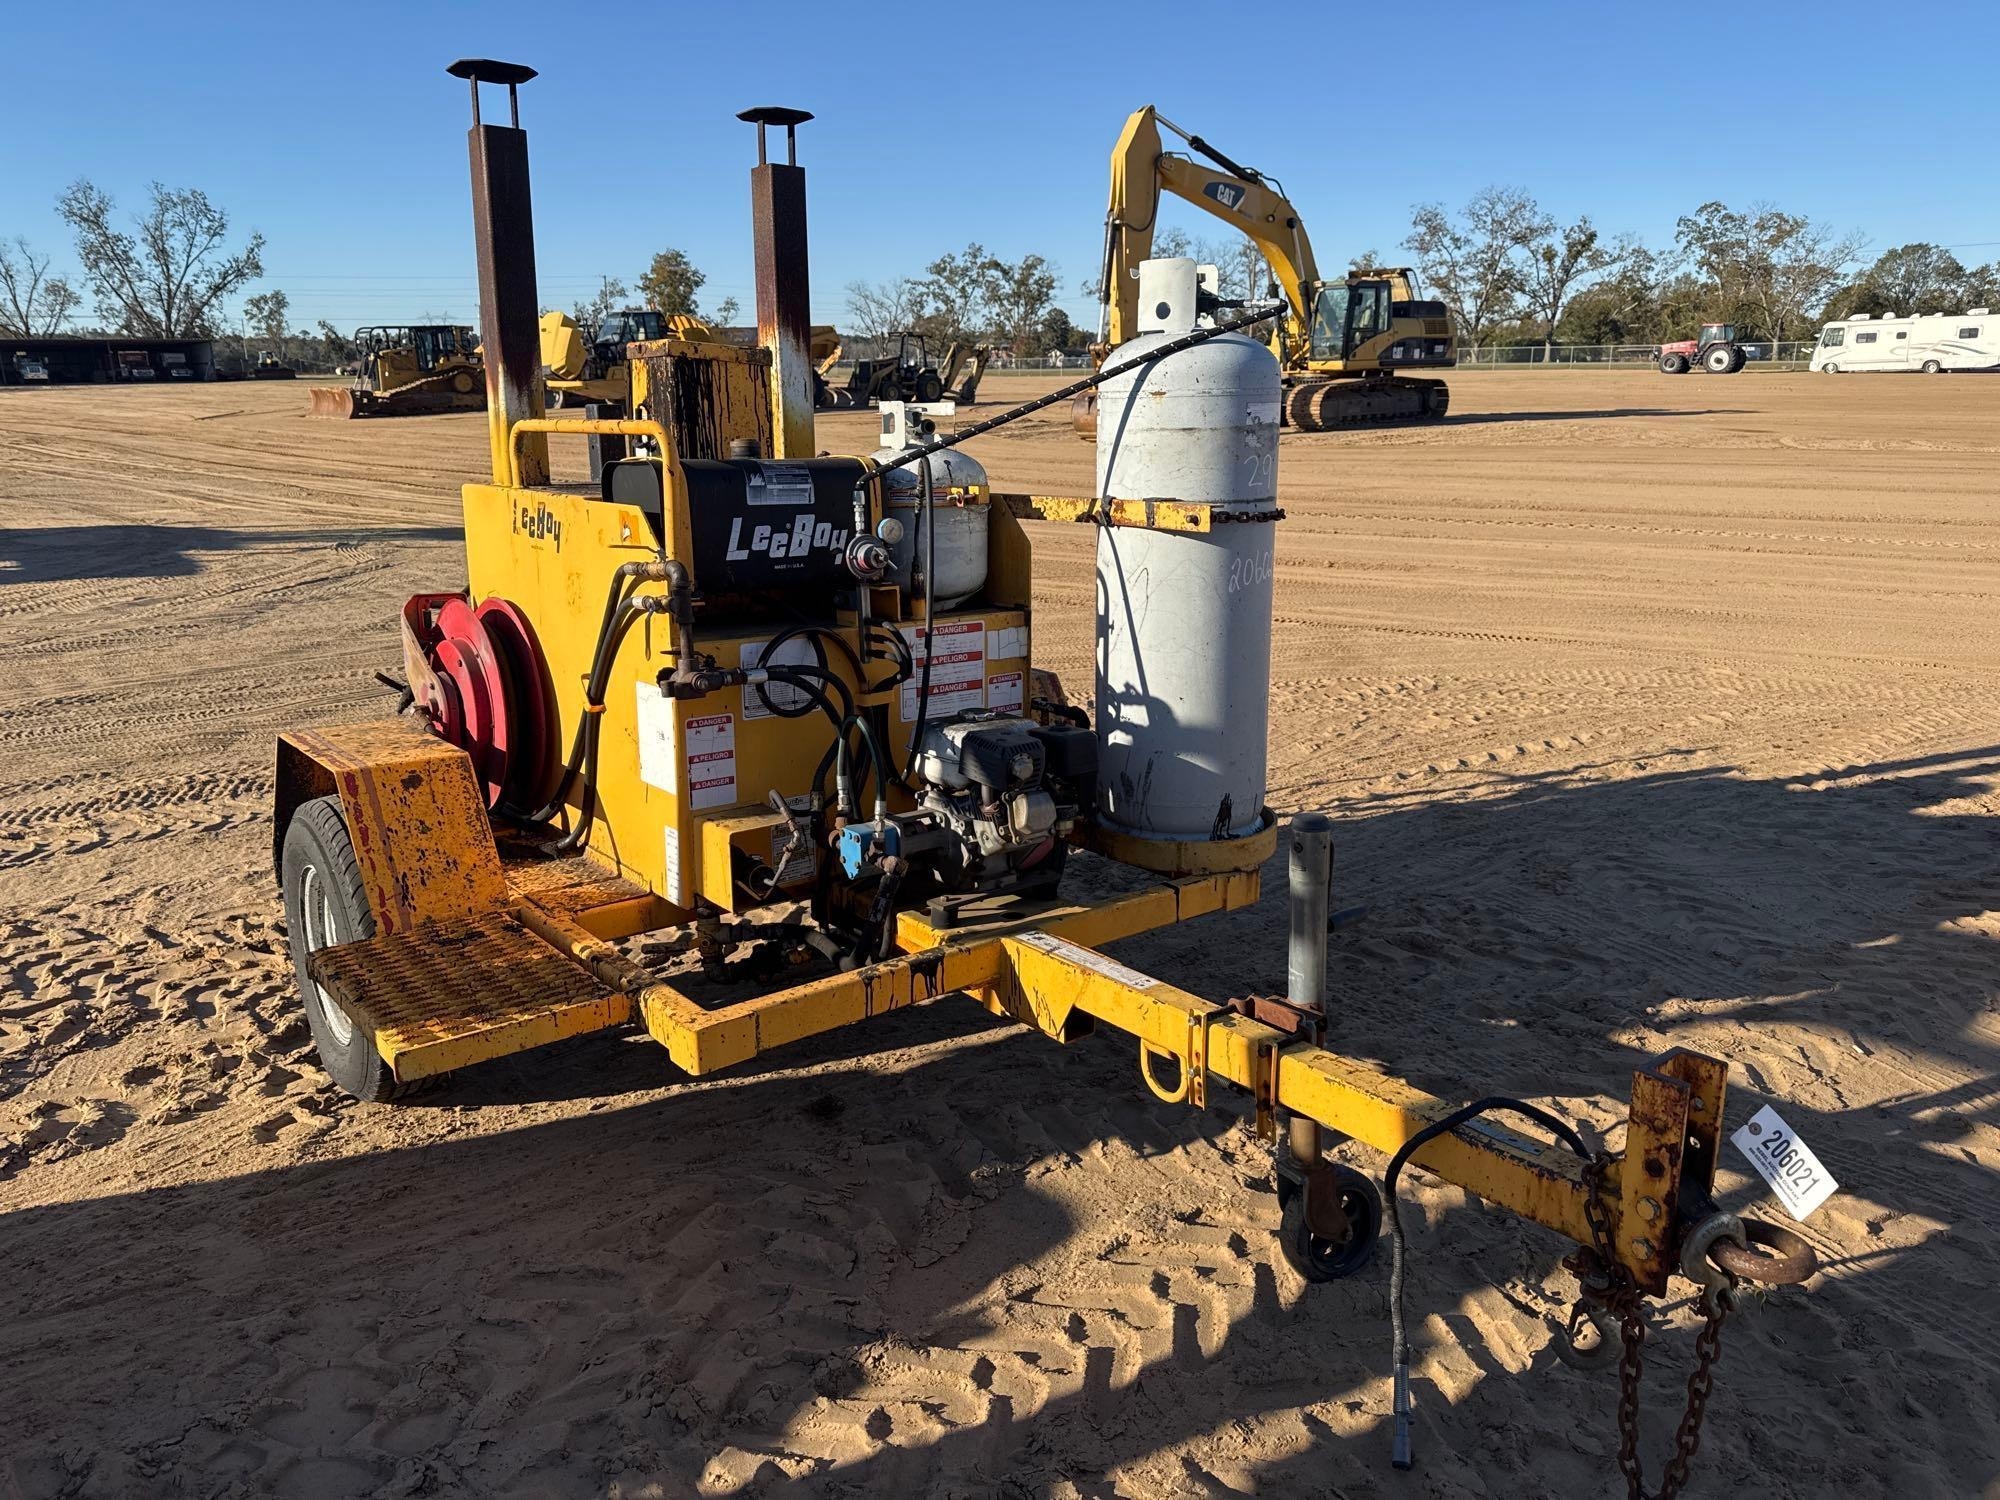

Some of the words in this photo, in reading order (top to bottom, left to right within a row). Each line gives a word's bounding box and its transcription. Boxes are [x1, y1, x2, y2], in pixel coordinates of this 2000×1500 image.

[1217, 184, 1235, 207] CAT
[726, 514, 848, 565] LeeBoy
[939, 625, 968, 634] DANGER
[938, 653, 968, 663] PELIGRO
[997, 674, 1018, 682] DANGER
[939, 681, 968, 693] DANGER
[698, 716, 727, 726] DANGER
[700, 751, 729, 761] PELIGRO
[701, 777, 730, 788] DANGER
[1761, 1130, 1819, 1195] 206021
